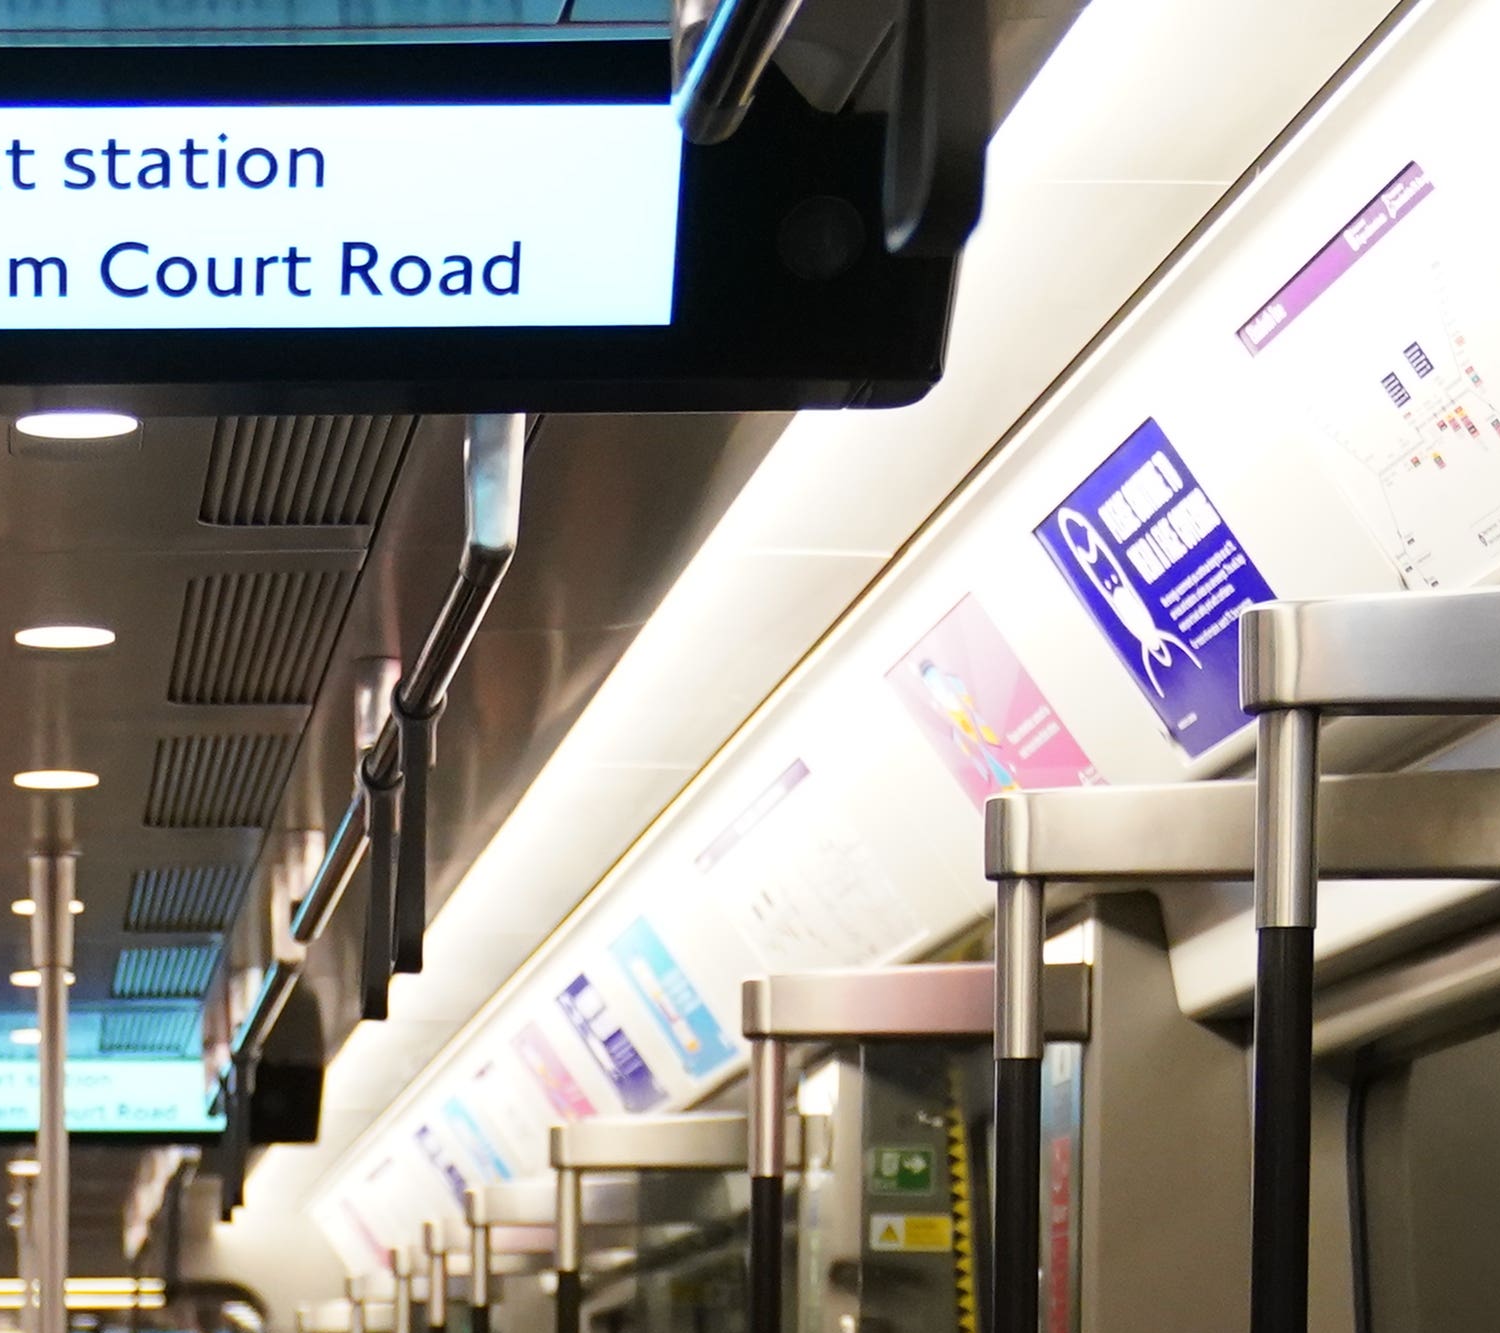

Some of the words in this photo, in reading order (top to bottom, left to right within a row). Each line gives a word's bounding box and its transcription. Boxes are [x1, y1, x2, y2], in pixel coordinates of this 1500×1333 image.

[65, 134, 324, 189] station
[101, 242, 311, 297] Court
[342, 241, 520, 296] Road
